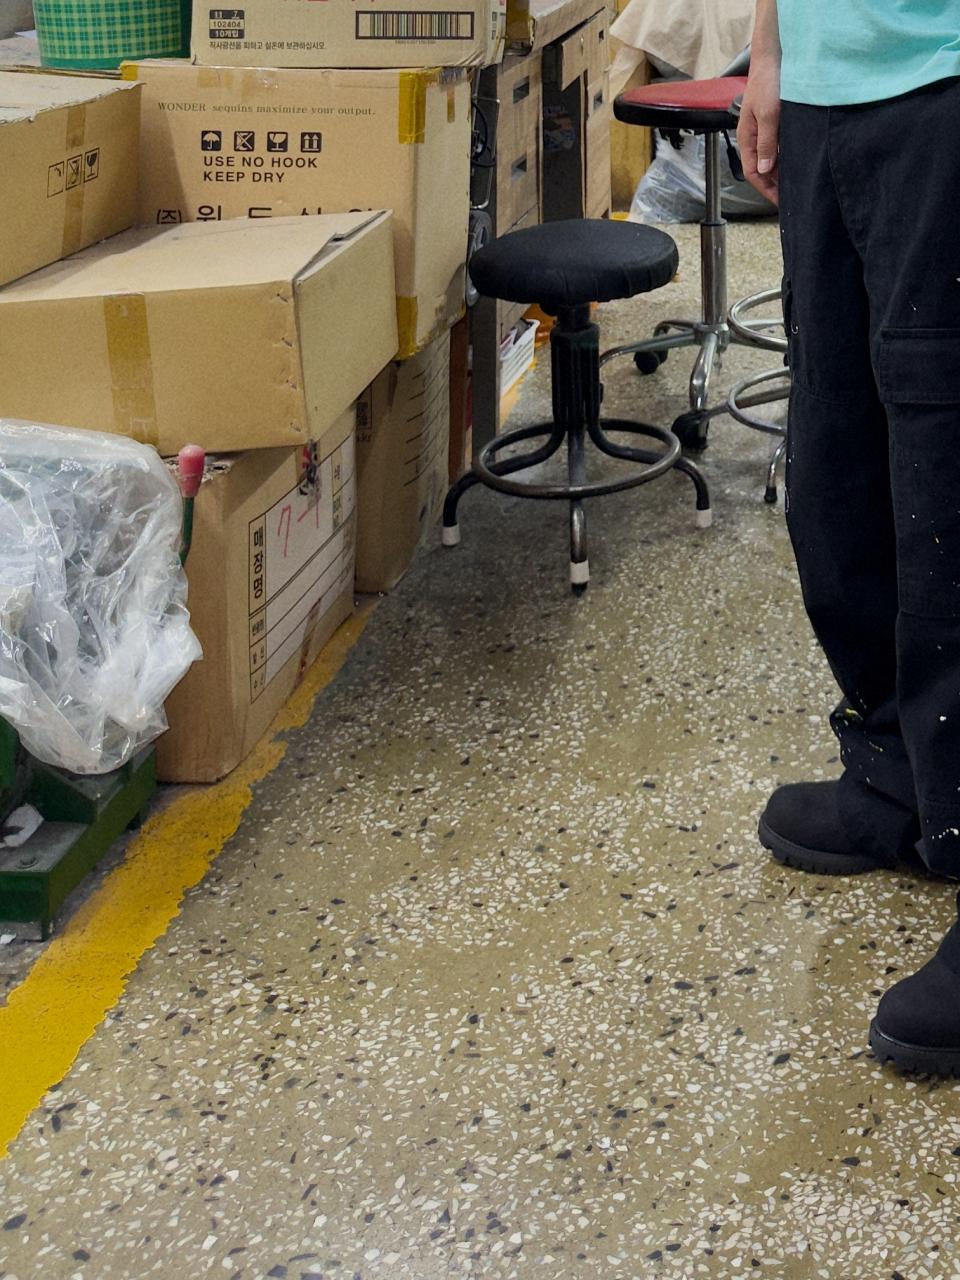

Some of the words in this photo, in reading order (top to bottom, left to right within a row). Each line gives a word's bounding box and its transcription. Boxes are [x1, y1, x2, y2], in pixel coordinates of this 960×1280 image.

[157, 101, 206, 112] WONDER
[311, 105, 335, 116] your
[203, 156, 236, 167] USE
[241, 156, 265, 168] NO
[271, 156, 318, 169] HOOK
[203, 170, 245, 182] KEEP
[252, 171, 285, 183] DRY
